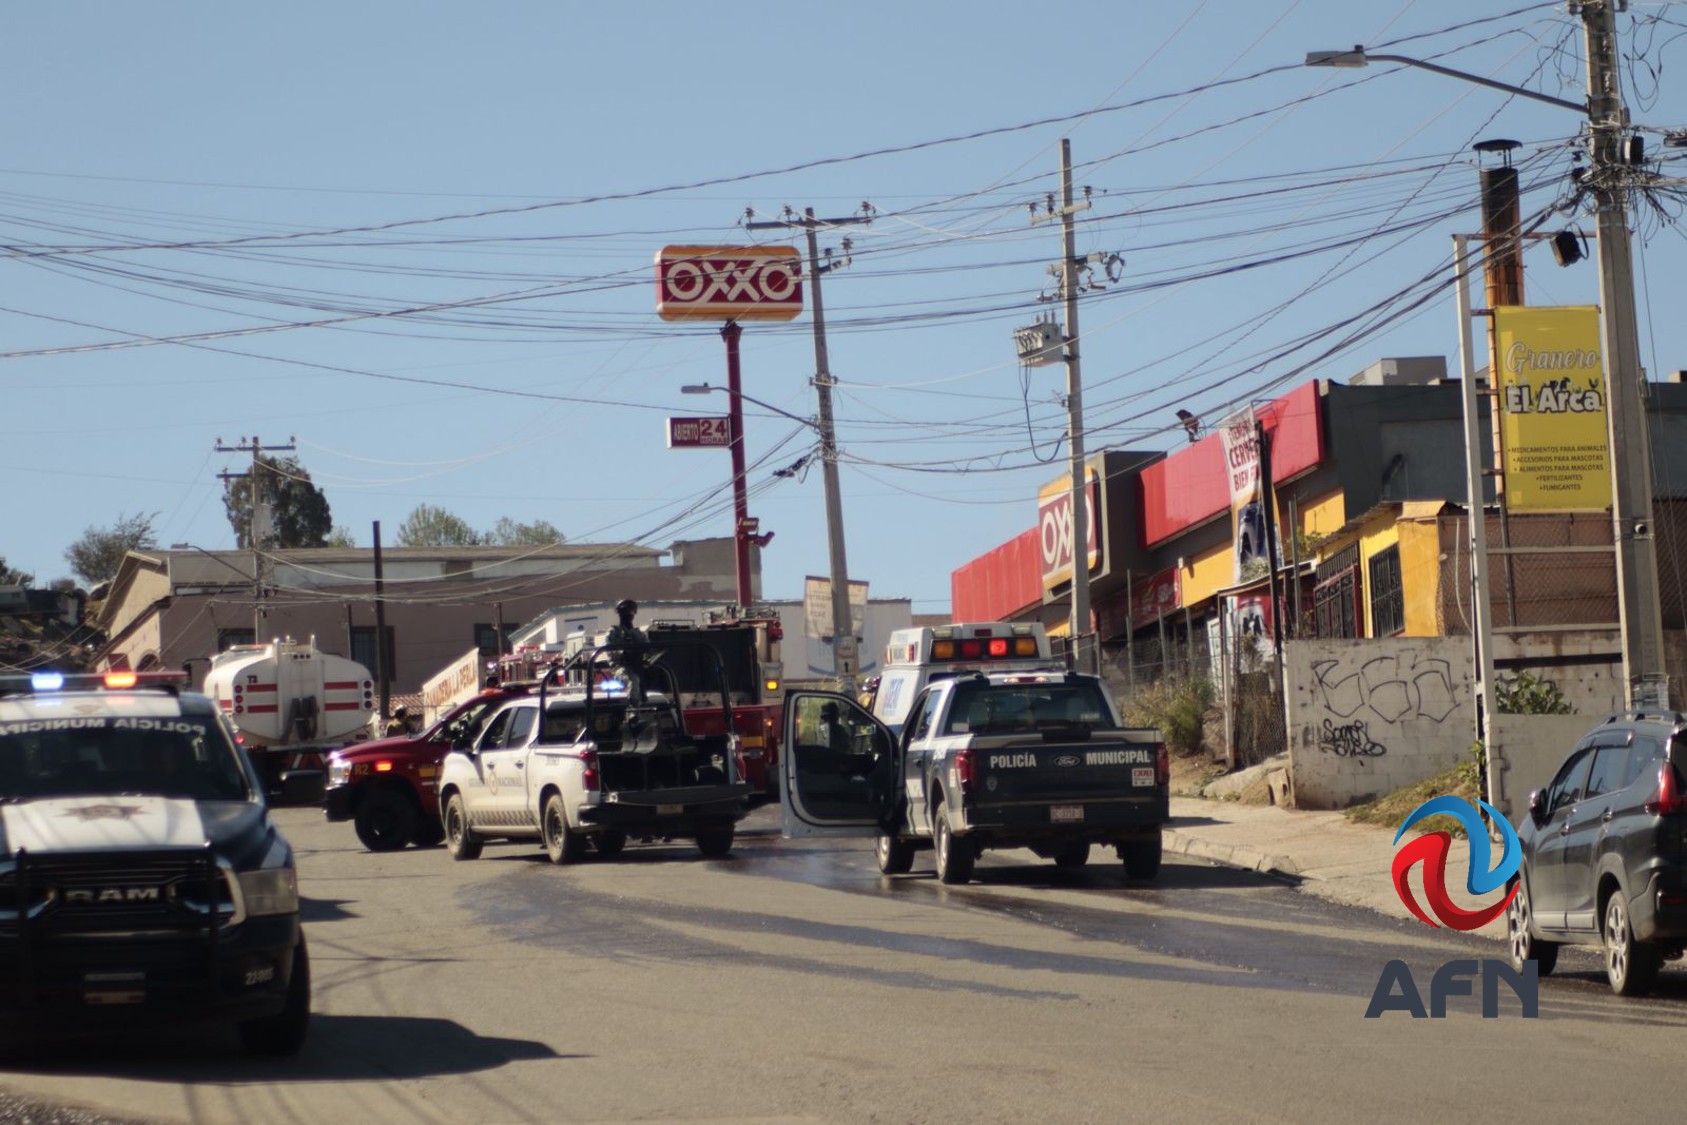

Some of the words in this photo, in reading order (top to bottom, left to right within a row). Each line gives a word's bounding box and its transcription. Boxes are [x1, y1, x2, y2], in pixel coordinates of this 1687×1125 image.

[666, 260, 796, 302] OXXO
[1506, 342, 1598, 374] Granero
[1537, 385, 1602, 413] Arca
[700, 420, 727, 437] 24
[1511, 446, 1559, 454] MEDICAMENTOS
[1560, 445, 1576, 453] PARA
[1577, 444, 1607, 452] ANIMALES
[1538, 474, 1583, 482] FERTILIZANTES
[990, 752, 1037, 769] POLICÍA
[1086, 751, 1150, 766] MUNICIPAL
[65, 888, 159, 902] RAM
